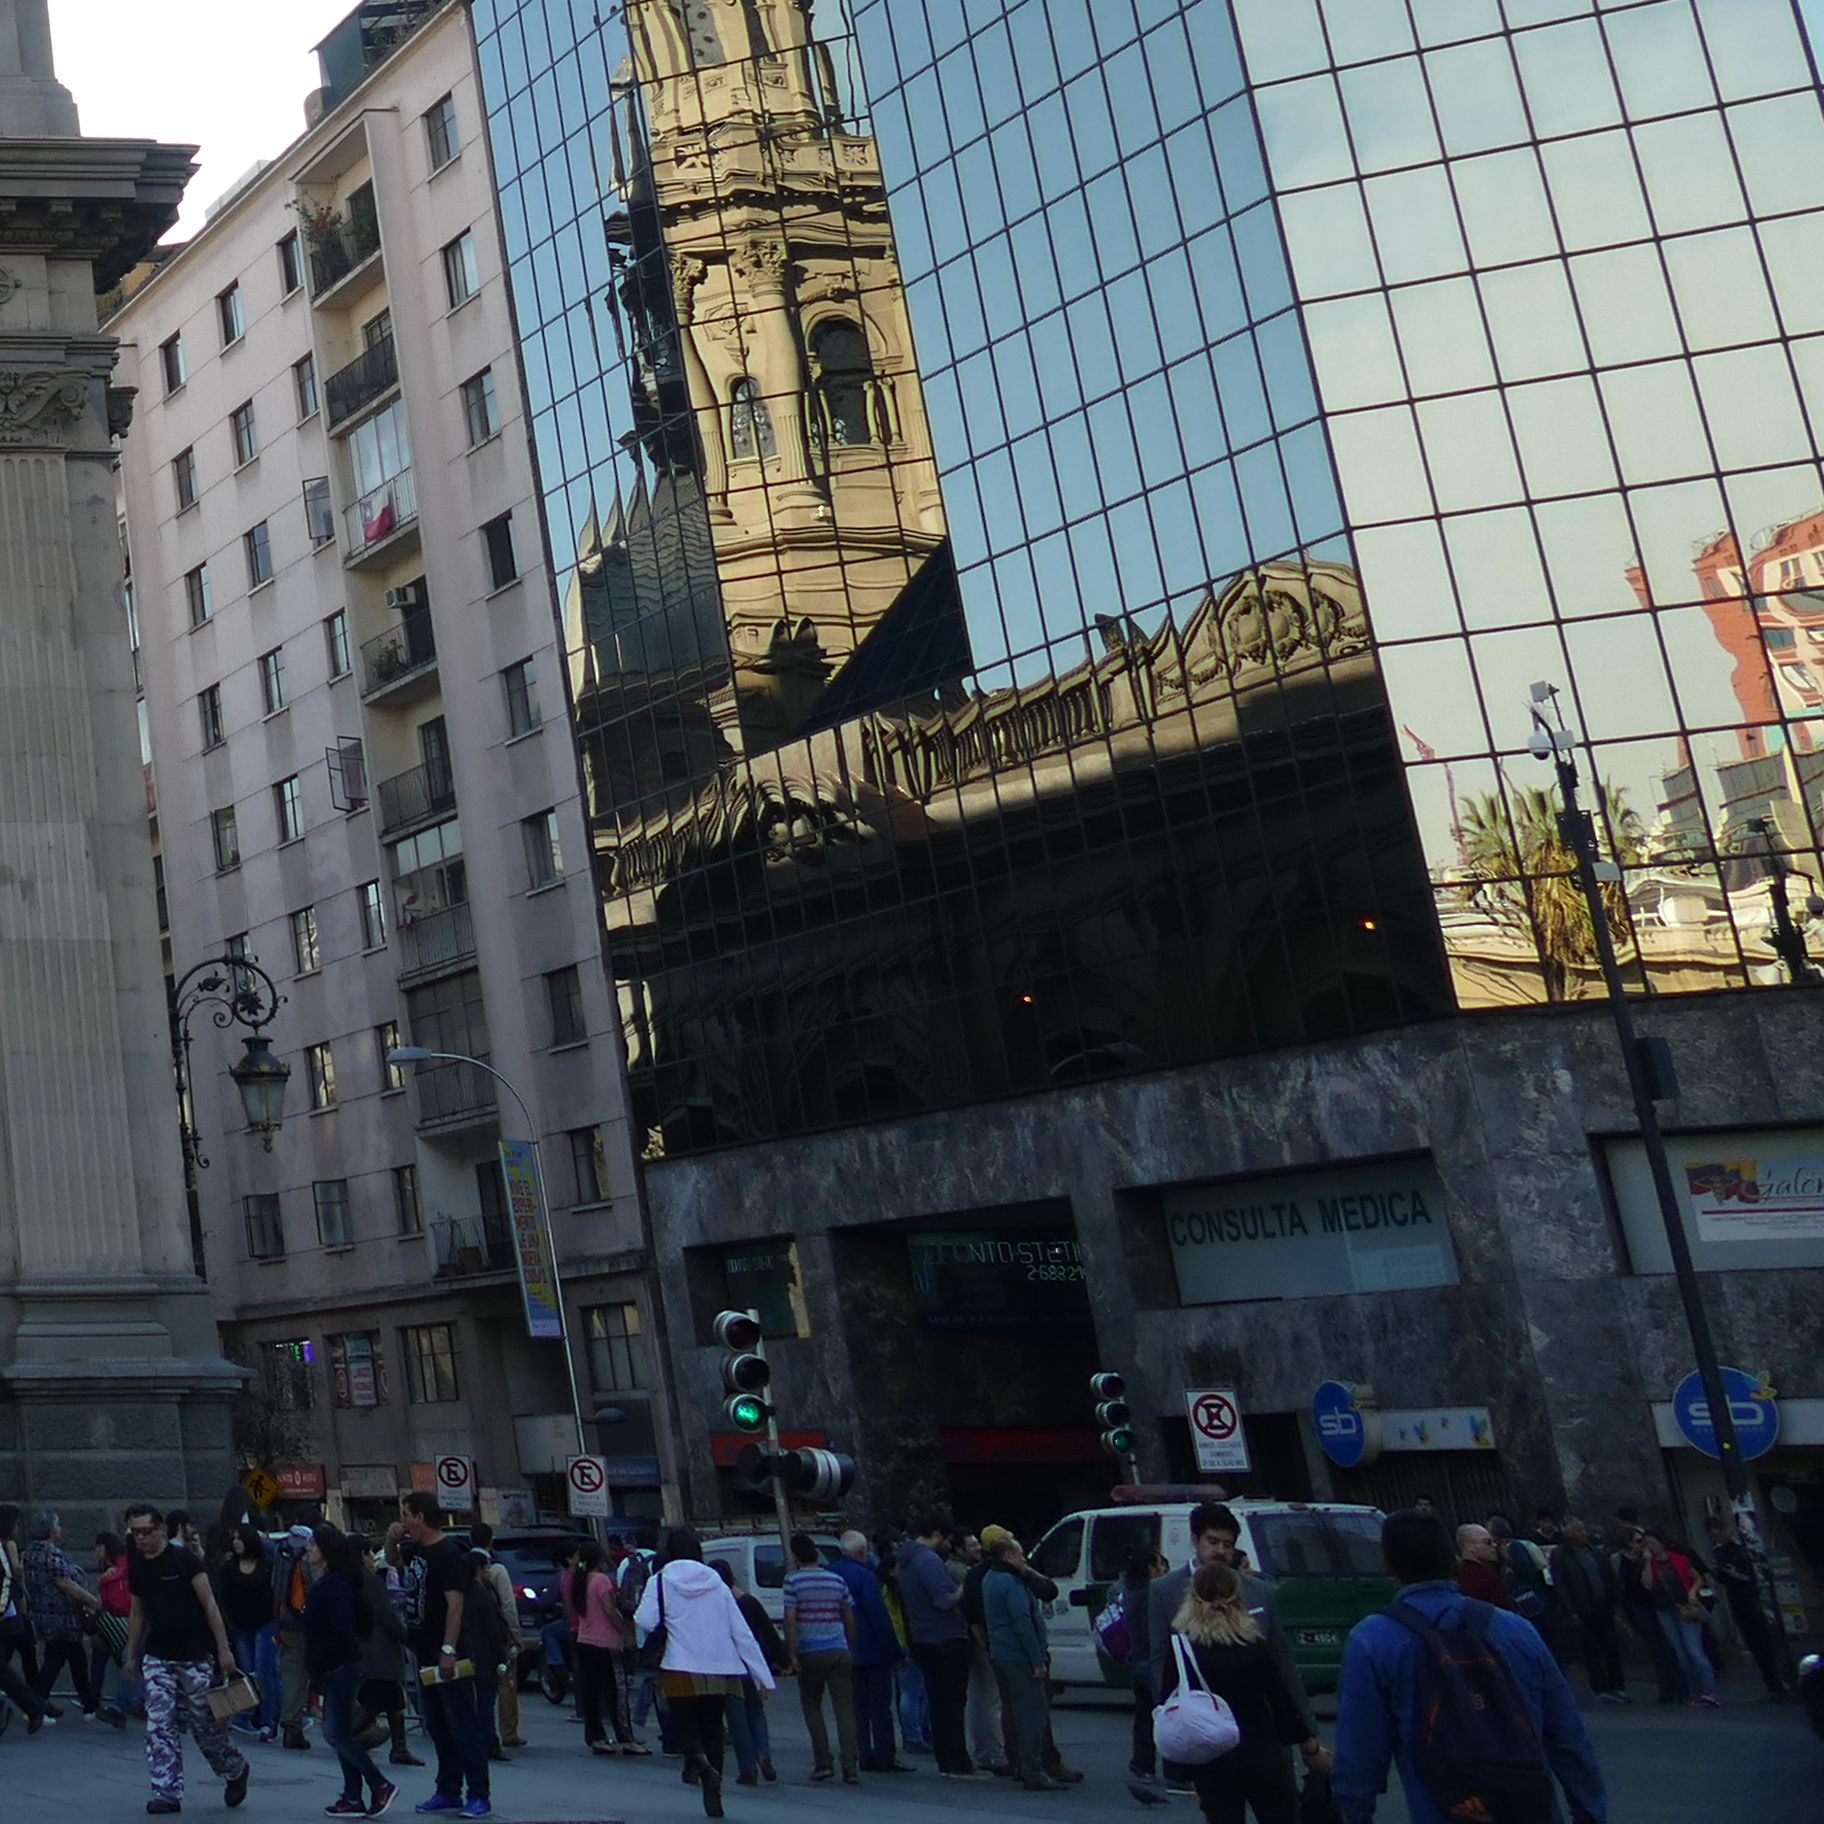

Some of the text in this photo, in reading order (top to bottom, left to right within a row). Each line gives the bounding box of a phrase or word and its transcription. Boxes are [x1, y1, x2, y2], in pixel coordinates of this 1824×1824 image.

[1171, 1190, 1433, 1246] CONSULTA MEDICA
[1318, 1405, 1357, 1436] sb
